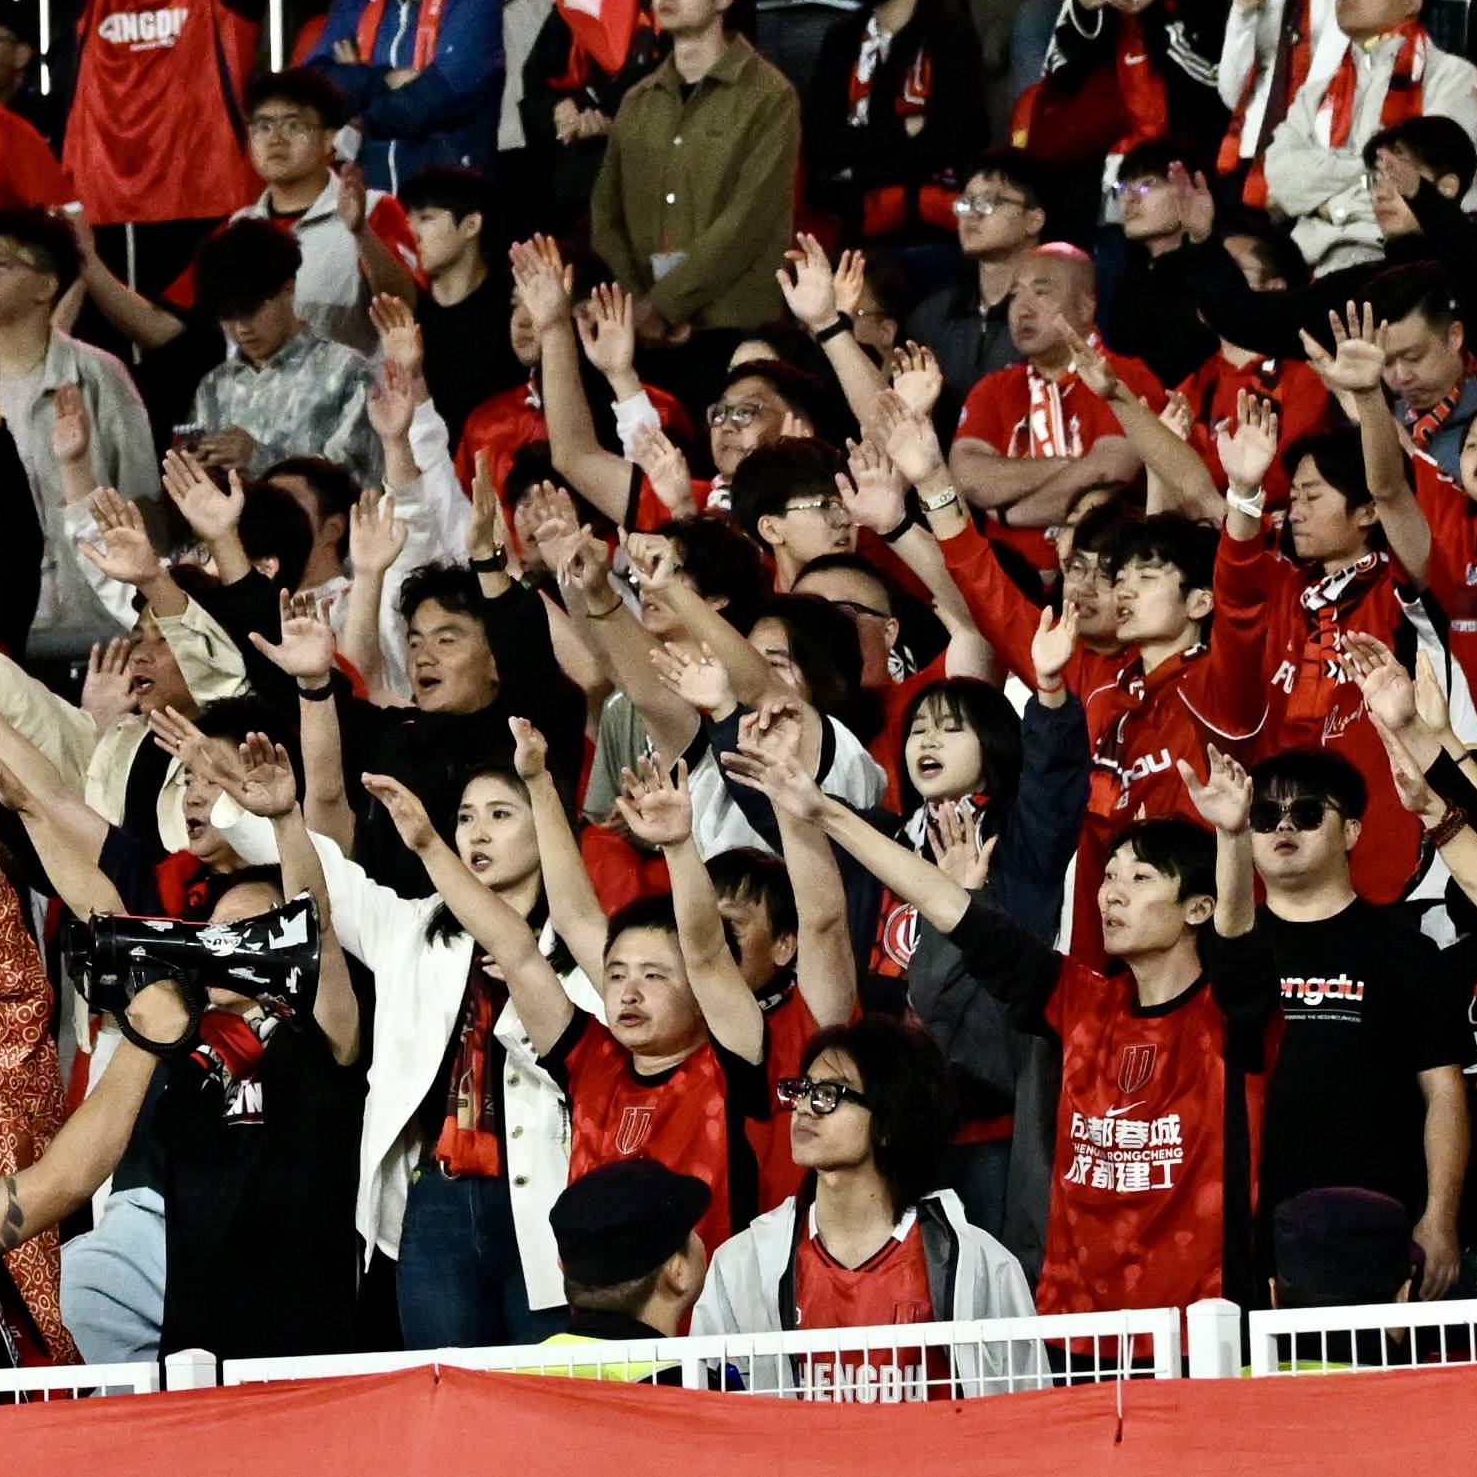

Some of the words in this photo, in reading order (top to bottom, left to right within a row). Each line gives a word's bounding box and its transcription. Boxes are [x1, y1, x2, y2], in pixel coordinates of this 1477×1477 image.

[1070, 1112, 1183, 1149] 成都蓉城
[1064, 1154, 1183, 1193] 成都建工
[798, 1363, 926, 1404] HENGDU
